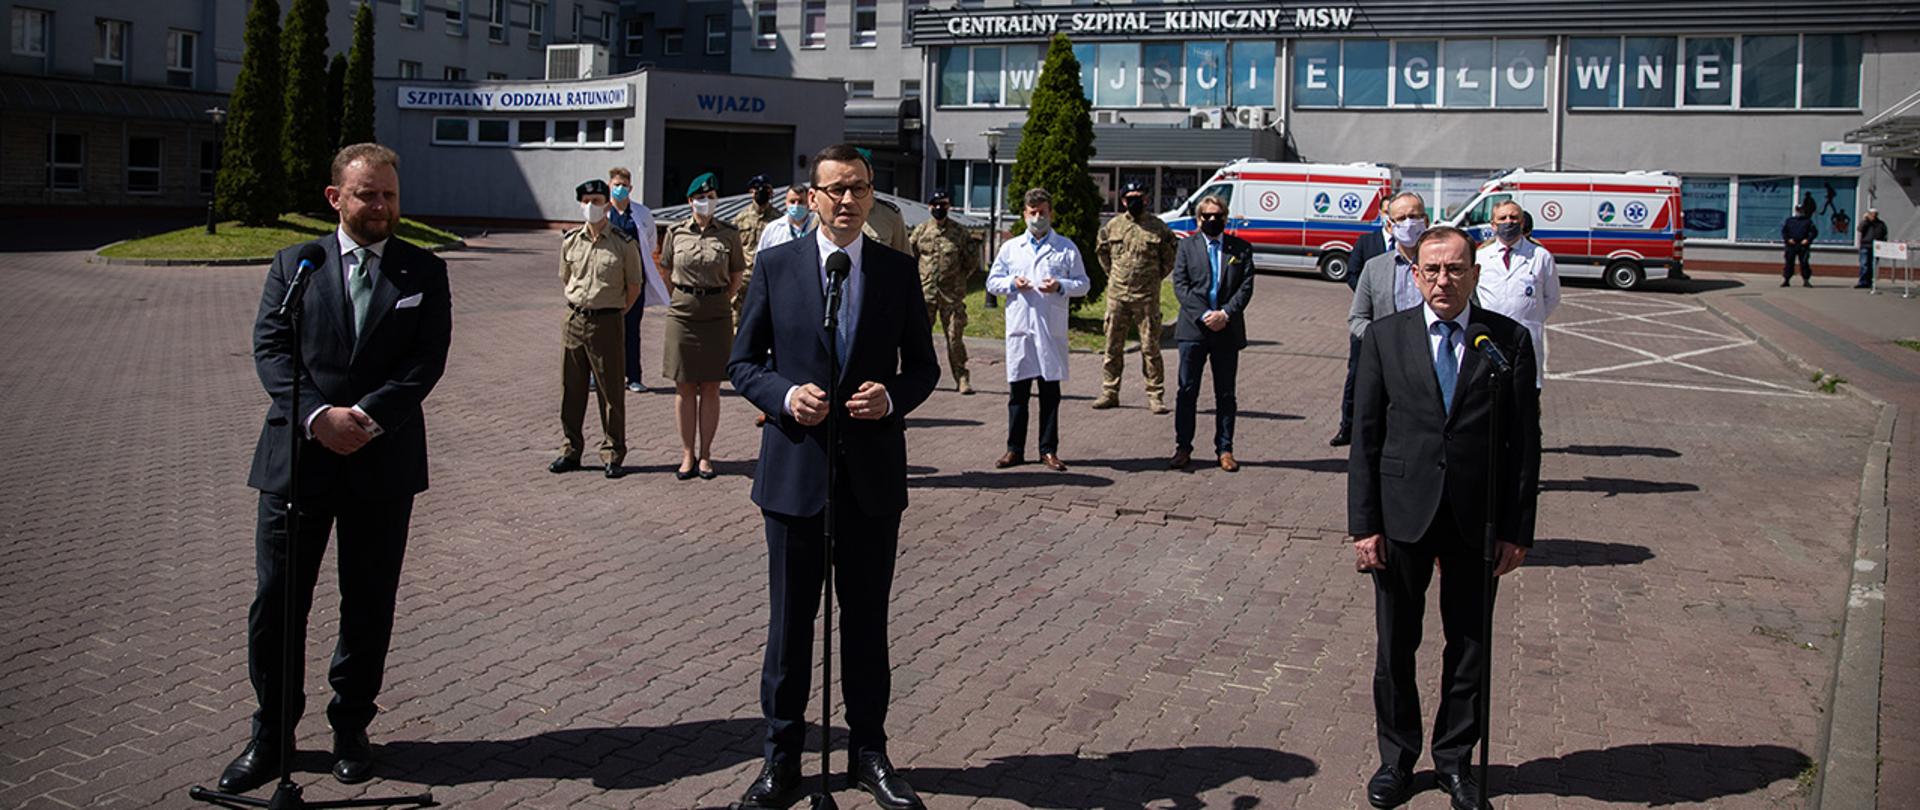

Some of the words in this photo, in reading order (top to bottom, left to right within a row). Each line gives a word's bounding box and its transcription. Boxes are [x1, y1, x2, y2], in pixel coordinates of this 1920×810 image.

[947, 14, 1059, 35] CENTRALNY
[1071, 12, 1150, 31] SZPITAL
[1165, 9, 1280, 30] KLINICZNY
[1295, 8, 1353, 27] MSW
[1403, 49, 1720, 90] GŁÓWNE
[407, 90, 494, 106] SZPITALNY
[500, 92, 562, 107] ODDZIAŁ
[567, 89, 625, 105] RATUNKOWY
[697, 94, 765, 114] WJAZD
[1265, 195, 1274, 207] S
[1547, 205, 1556, 217] S
